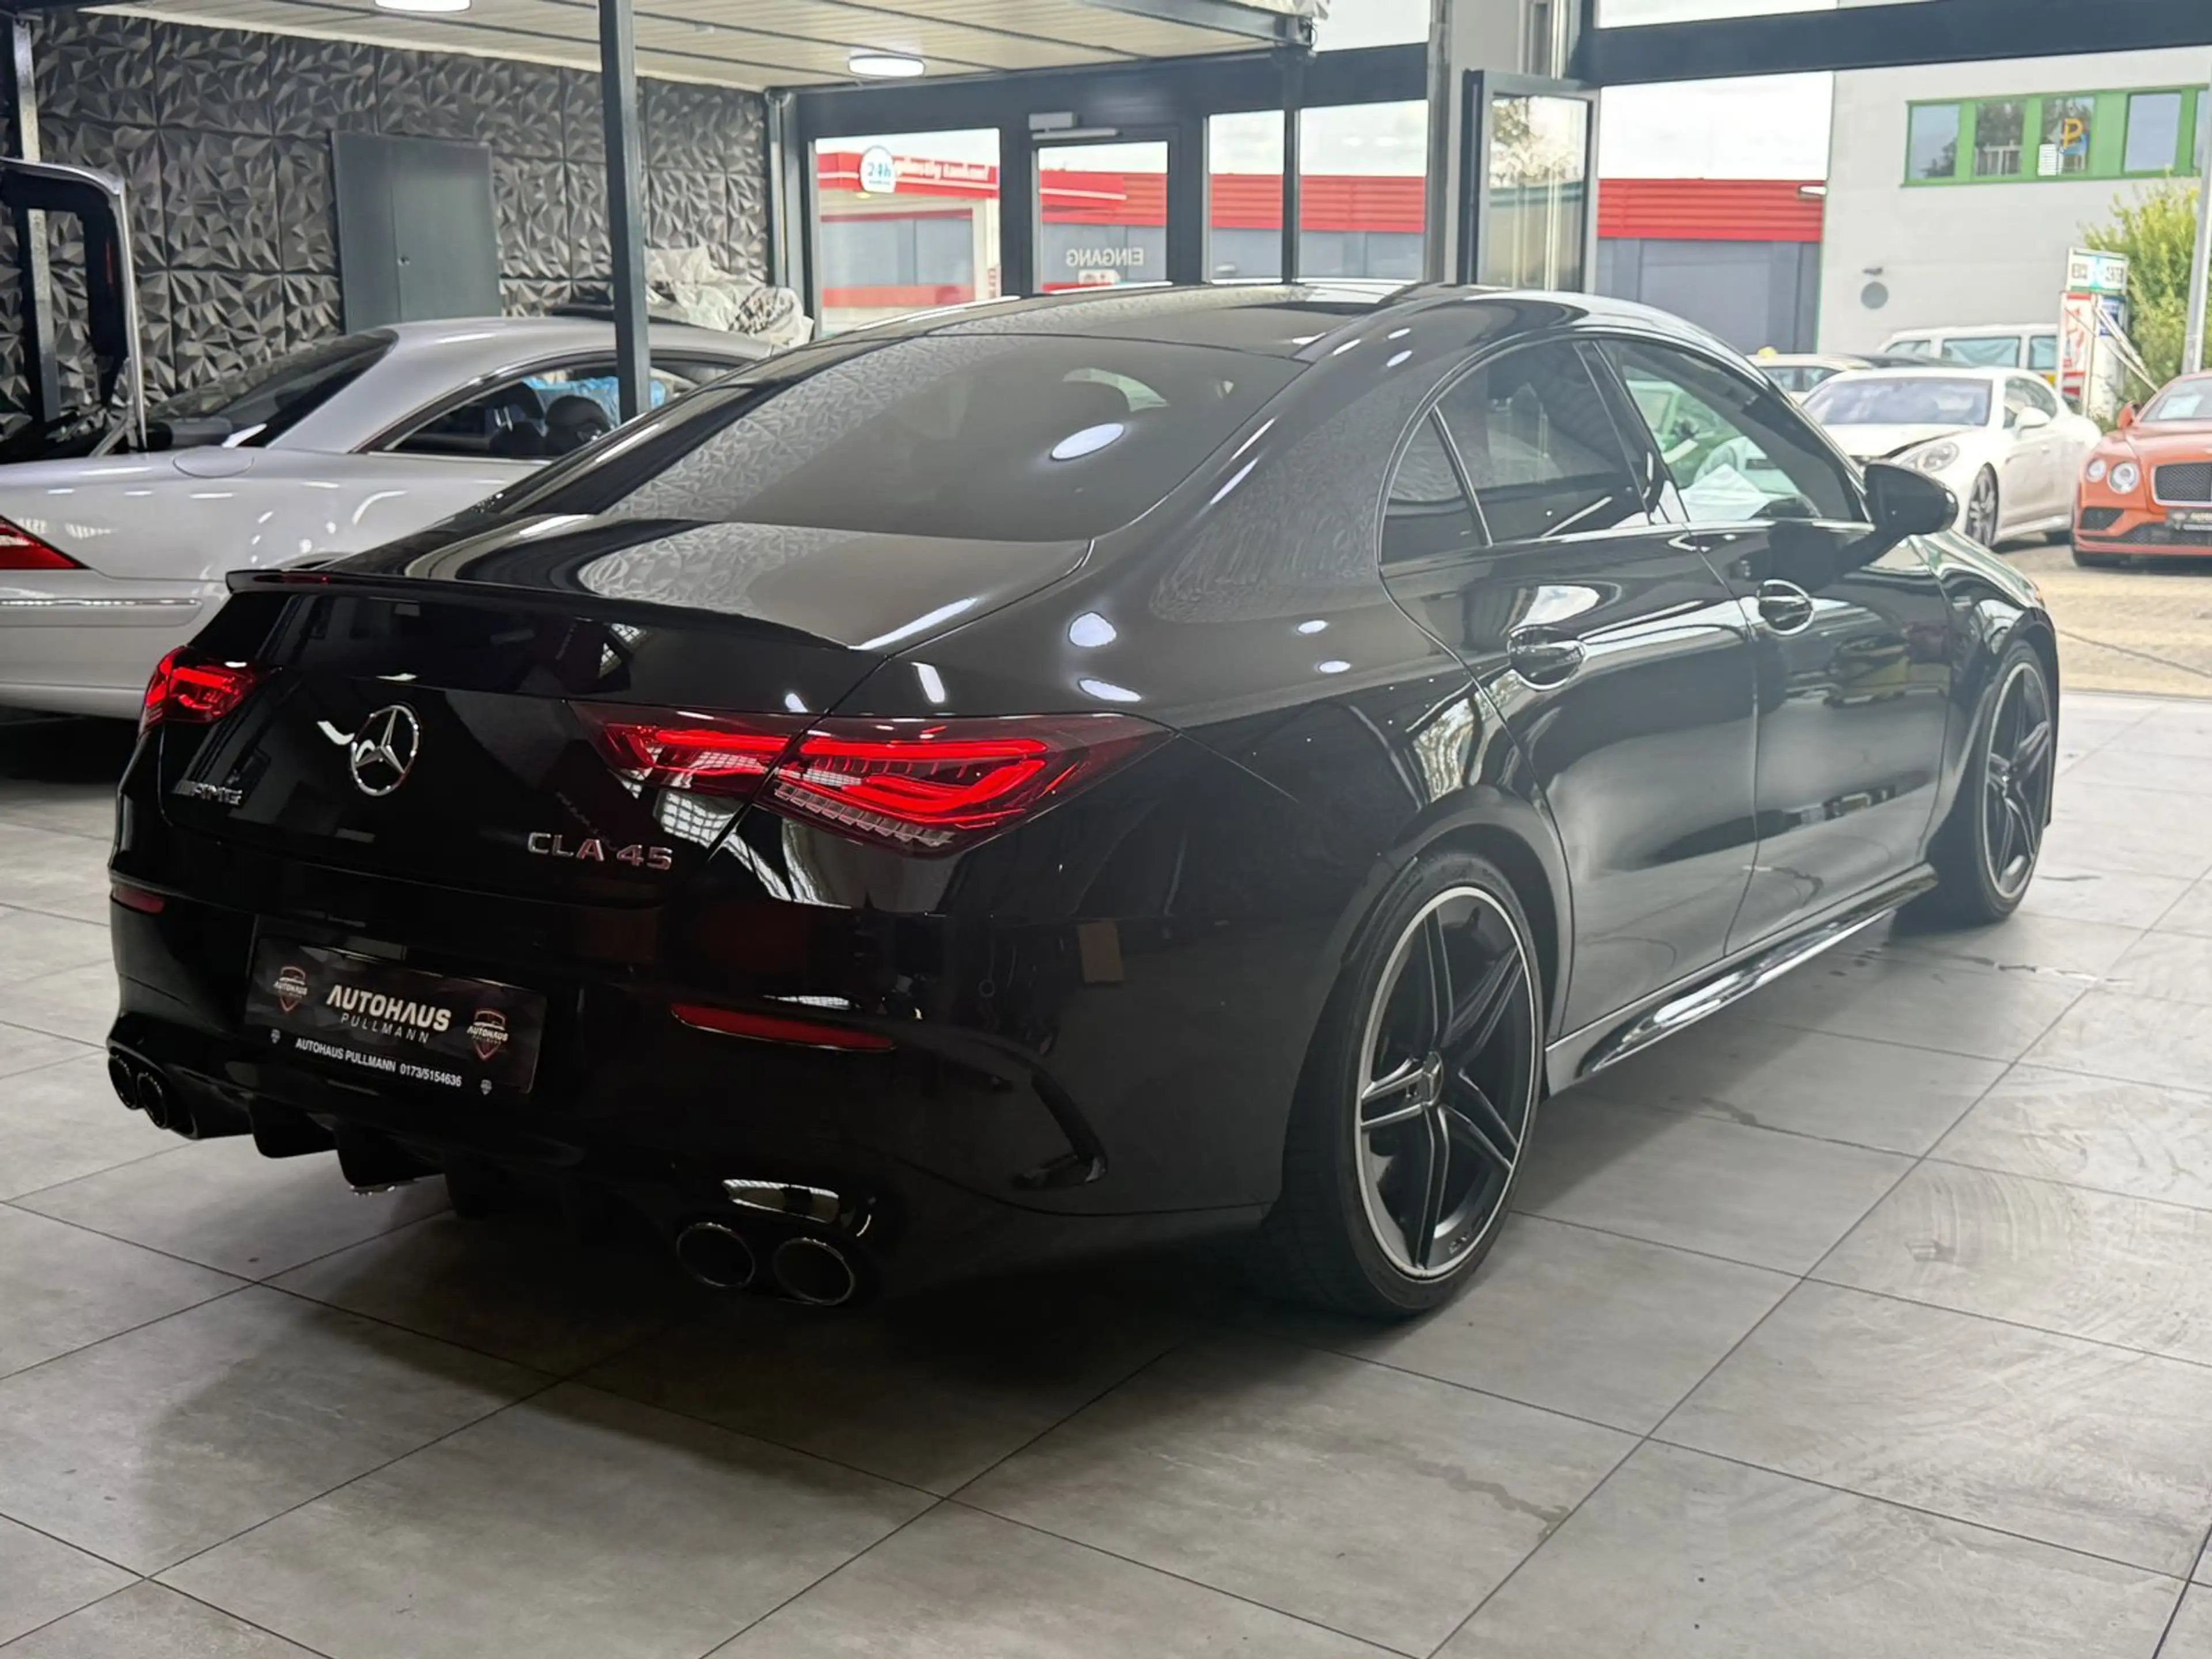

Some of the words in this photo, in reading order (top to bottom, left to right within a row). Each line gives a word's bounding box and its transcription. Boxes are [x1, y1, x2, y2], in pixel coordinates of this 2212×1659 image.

[192, 781, 243, 805] AMG
[527, 831, 605, 862] CLA
[616, 844, 673, 870] 45
[325, 984, 452, 1031] AUTOHAUS
[340, 1012, 430, 1044] PULLMANN
[295, 1037, 344, 1060] AUTOHAUS
[344, 1049, 397, 1072] PULLMANN
[399, 1063, 463, 1088] 0173/5154636
